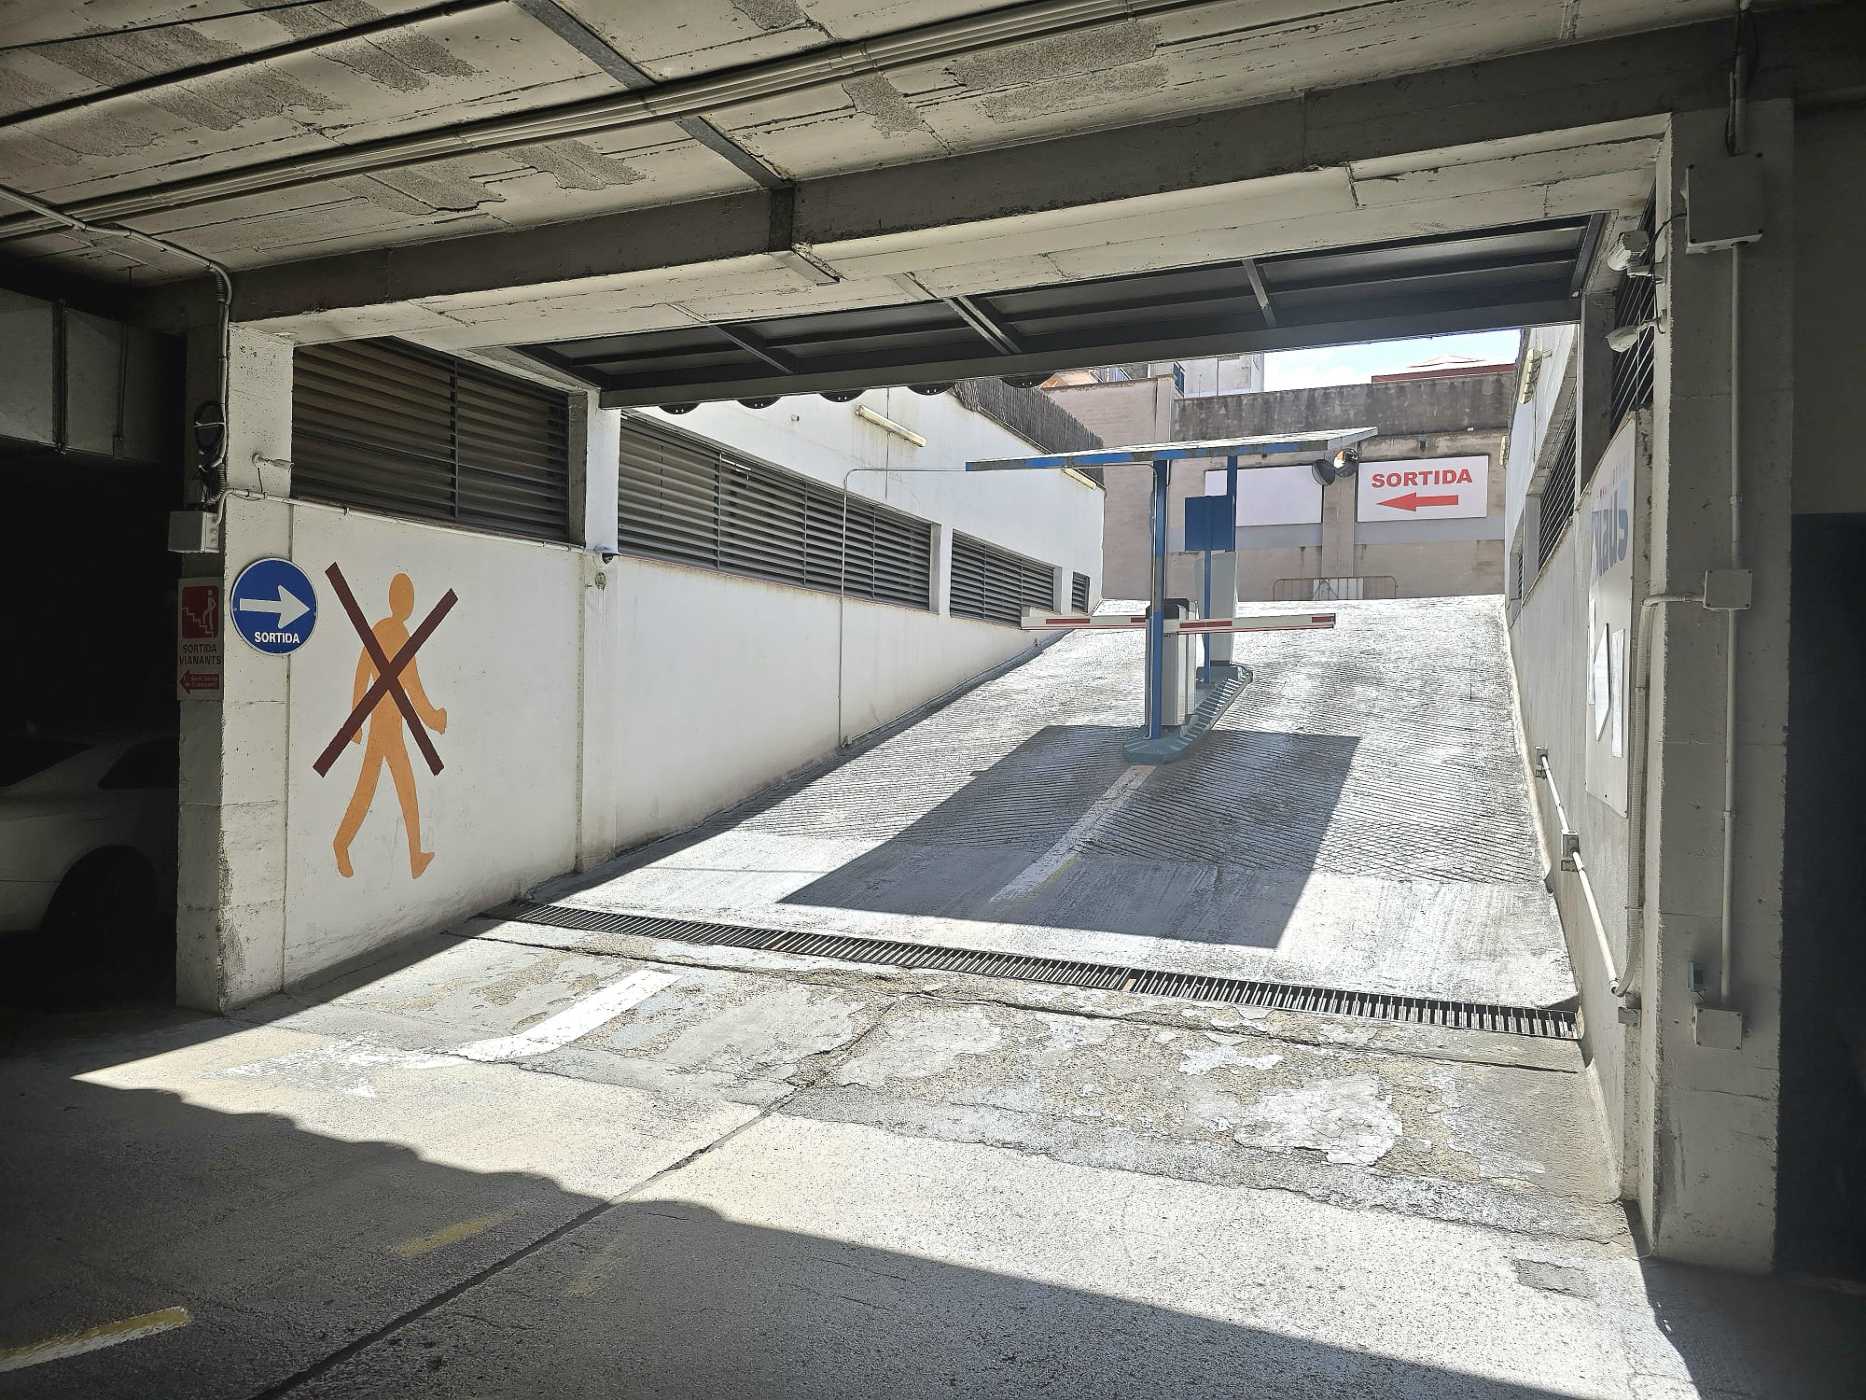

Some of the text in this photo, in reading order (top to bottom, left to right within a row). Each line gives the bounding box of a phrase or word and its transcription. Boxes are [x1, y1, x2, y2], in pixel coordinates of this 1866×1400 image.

[1371, 468, 1473, 489] SORTIDA
[254, 632, 301, 644] SORTIDA
[182, 643, 218, 655] SORTIDA
[179, 655, 223, 665] VIANANTS
